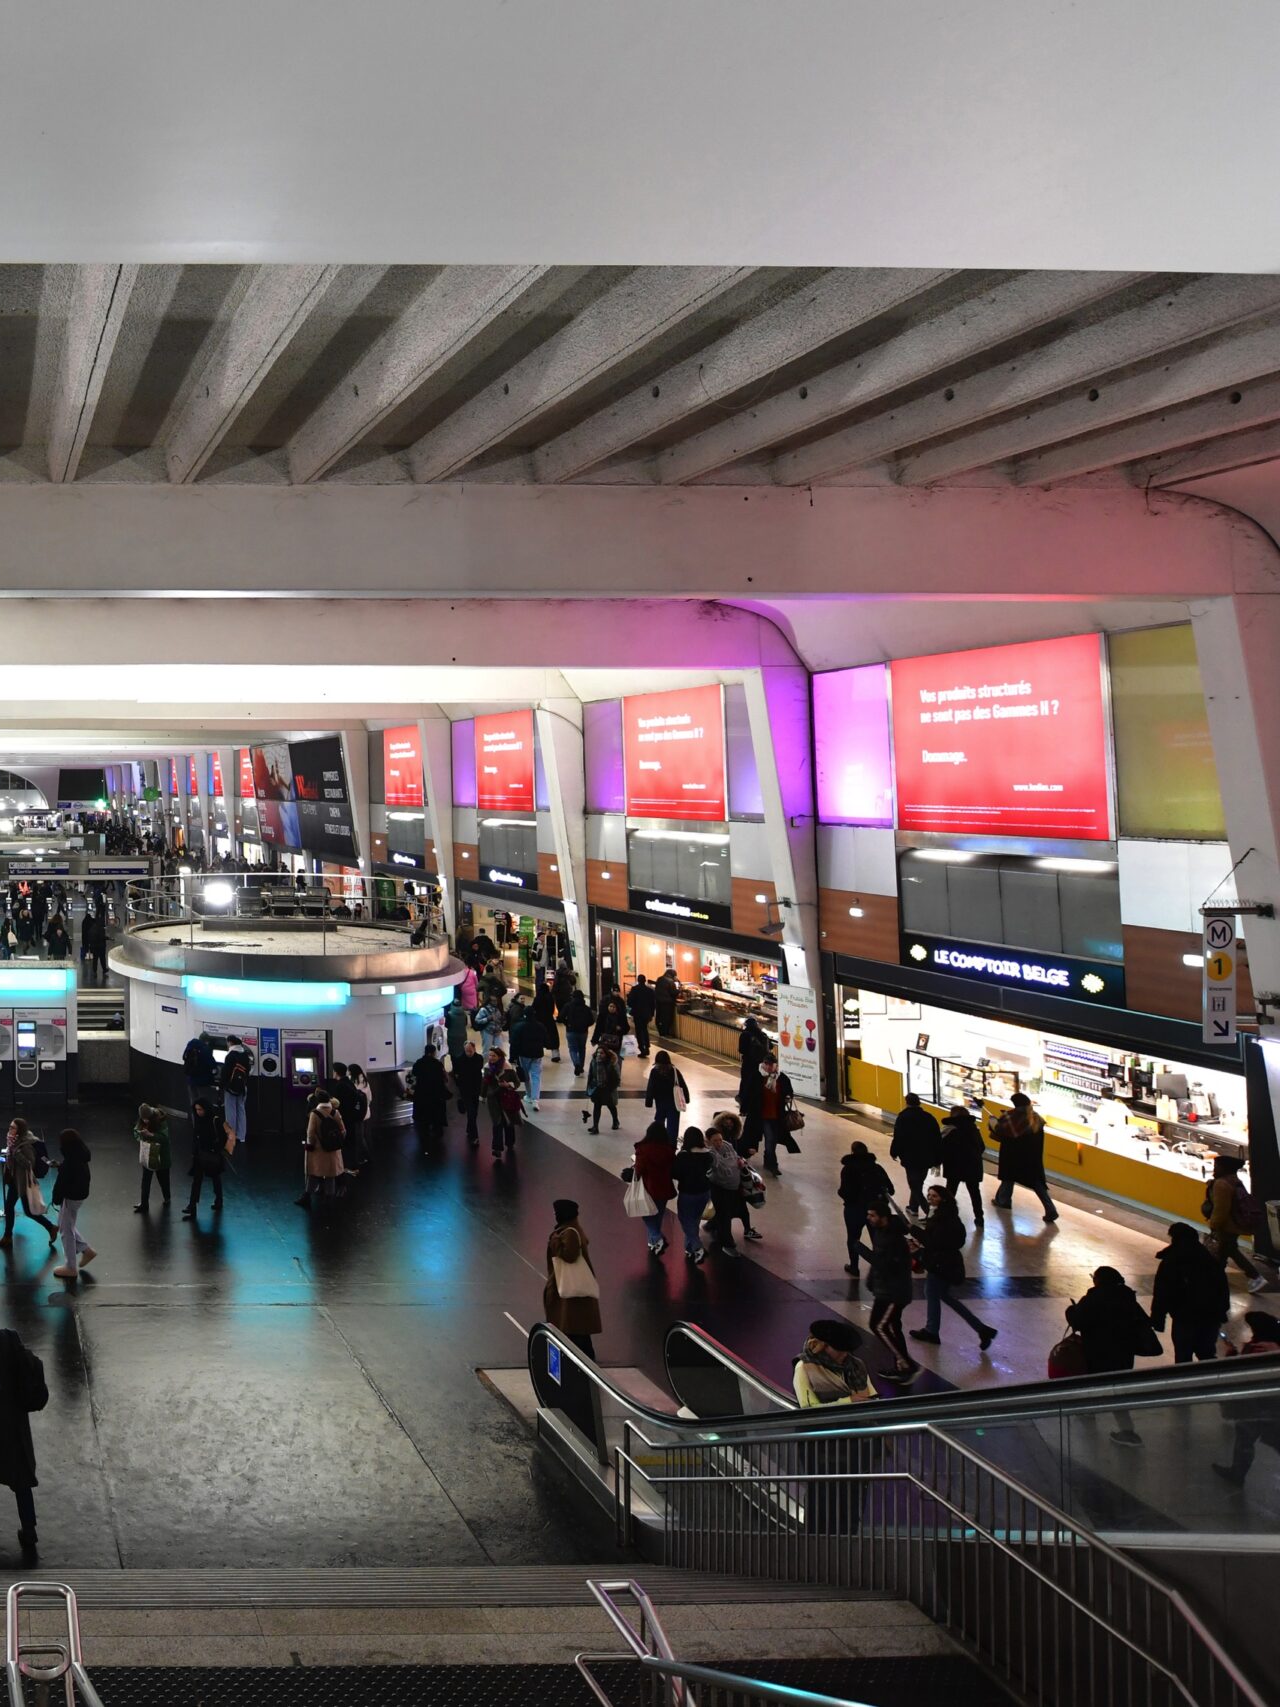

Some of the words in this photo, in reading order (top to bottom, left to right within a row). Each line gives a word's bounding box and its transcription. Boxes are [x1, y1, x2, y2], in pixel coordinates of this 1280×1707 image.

[938, 686, 976, 705] produits
[954, 708, 971, 724] pas
[973, 705, 991, 720] des
[993, 703, 1038, 718] Gammes
[1051, 700, 1059, 715] ?
[1211, 926, 1226, 942] M
[933, 949, 950, 965] LE
[949, 951, 1021, 979] COMPTOIR
[1021, 963, 1070, 987] BELGE
[1214, 958, 1222, 975] 1
